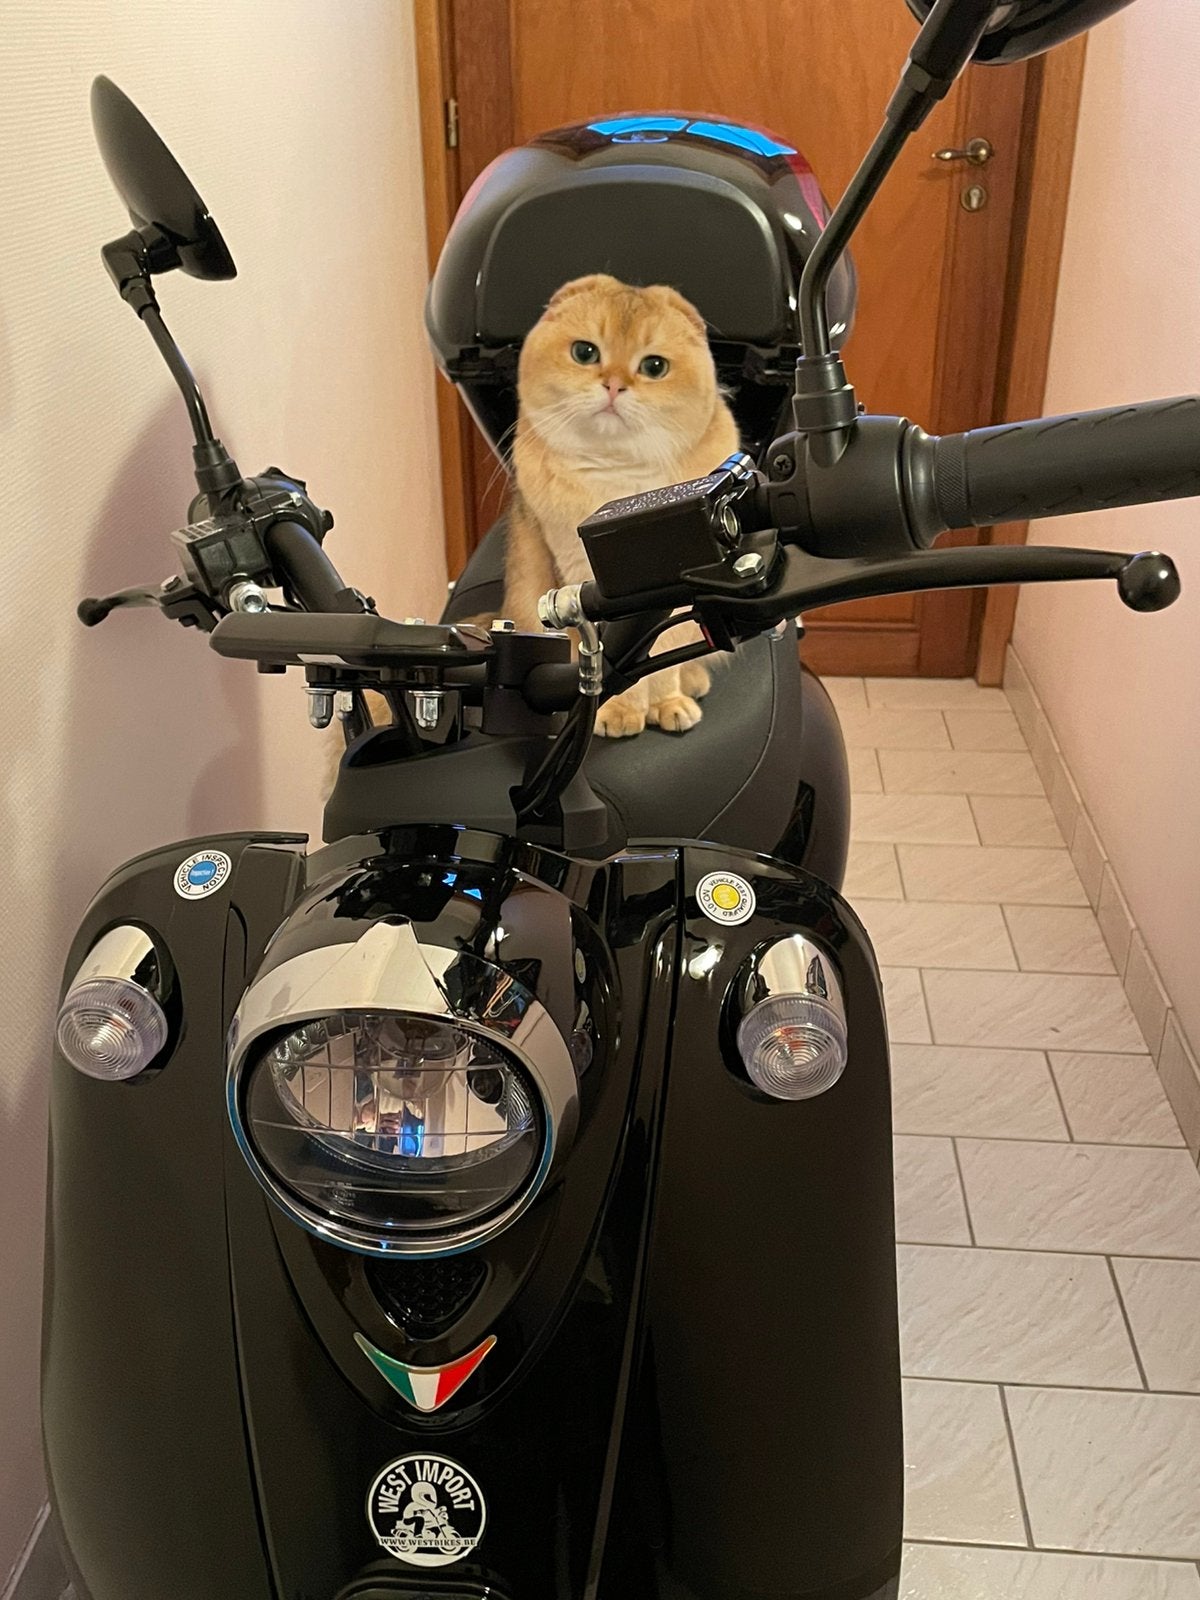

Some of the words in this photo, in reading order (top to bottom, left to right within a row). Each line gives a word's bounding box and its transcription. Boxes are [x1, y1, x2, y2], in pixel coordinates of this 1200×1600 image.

[202, 854, 226, 891] INSPECTION
[709, 877, 735, 887] VEHICLE
[735, 882, 748, 897] TEST
[378, 1464, 412, 1514] WEST
[414, 1460, 475, 1511] IMPORT
